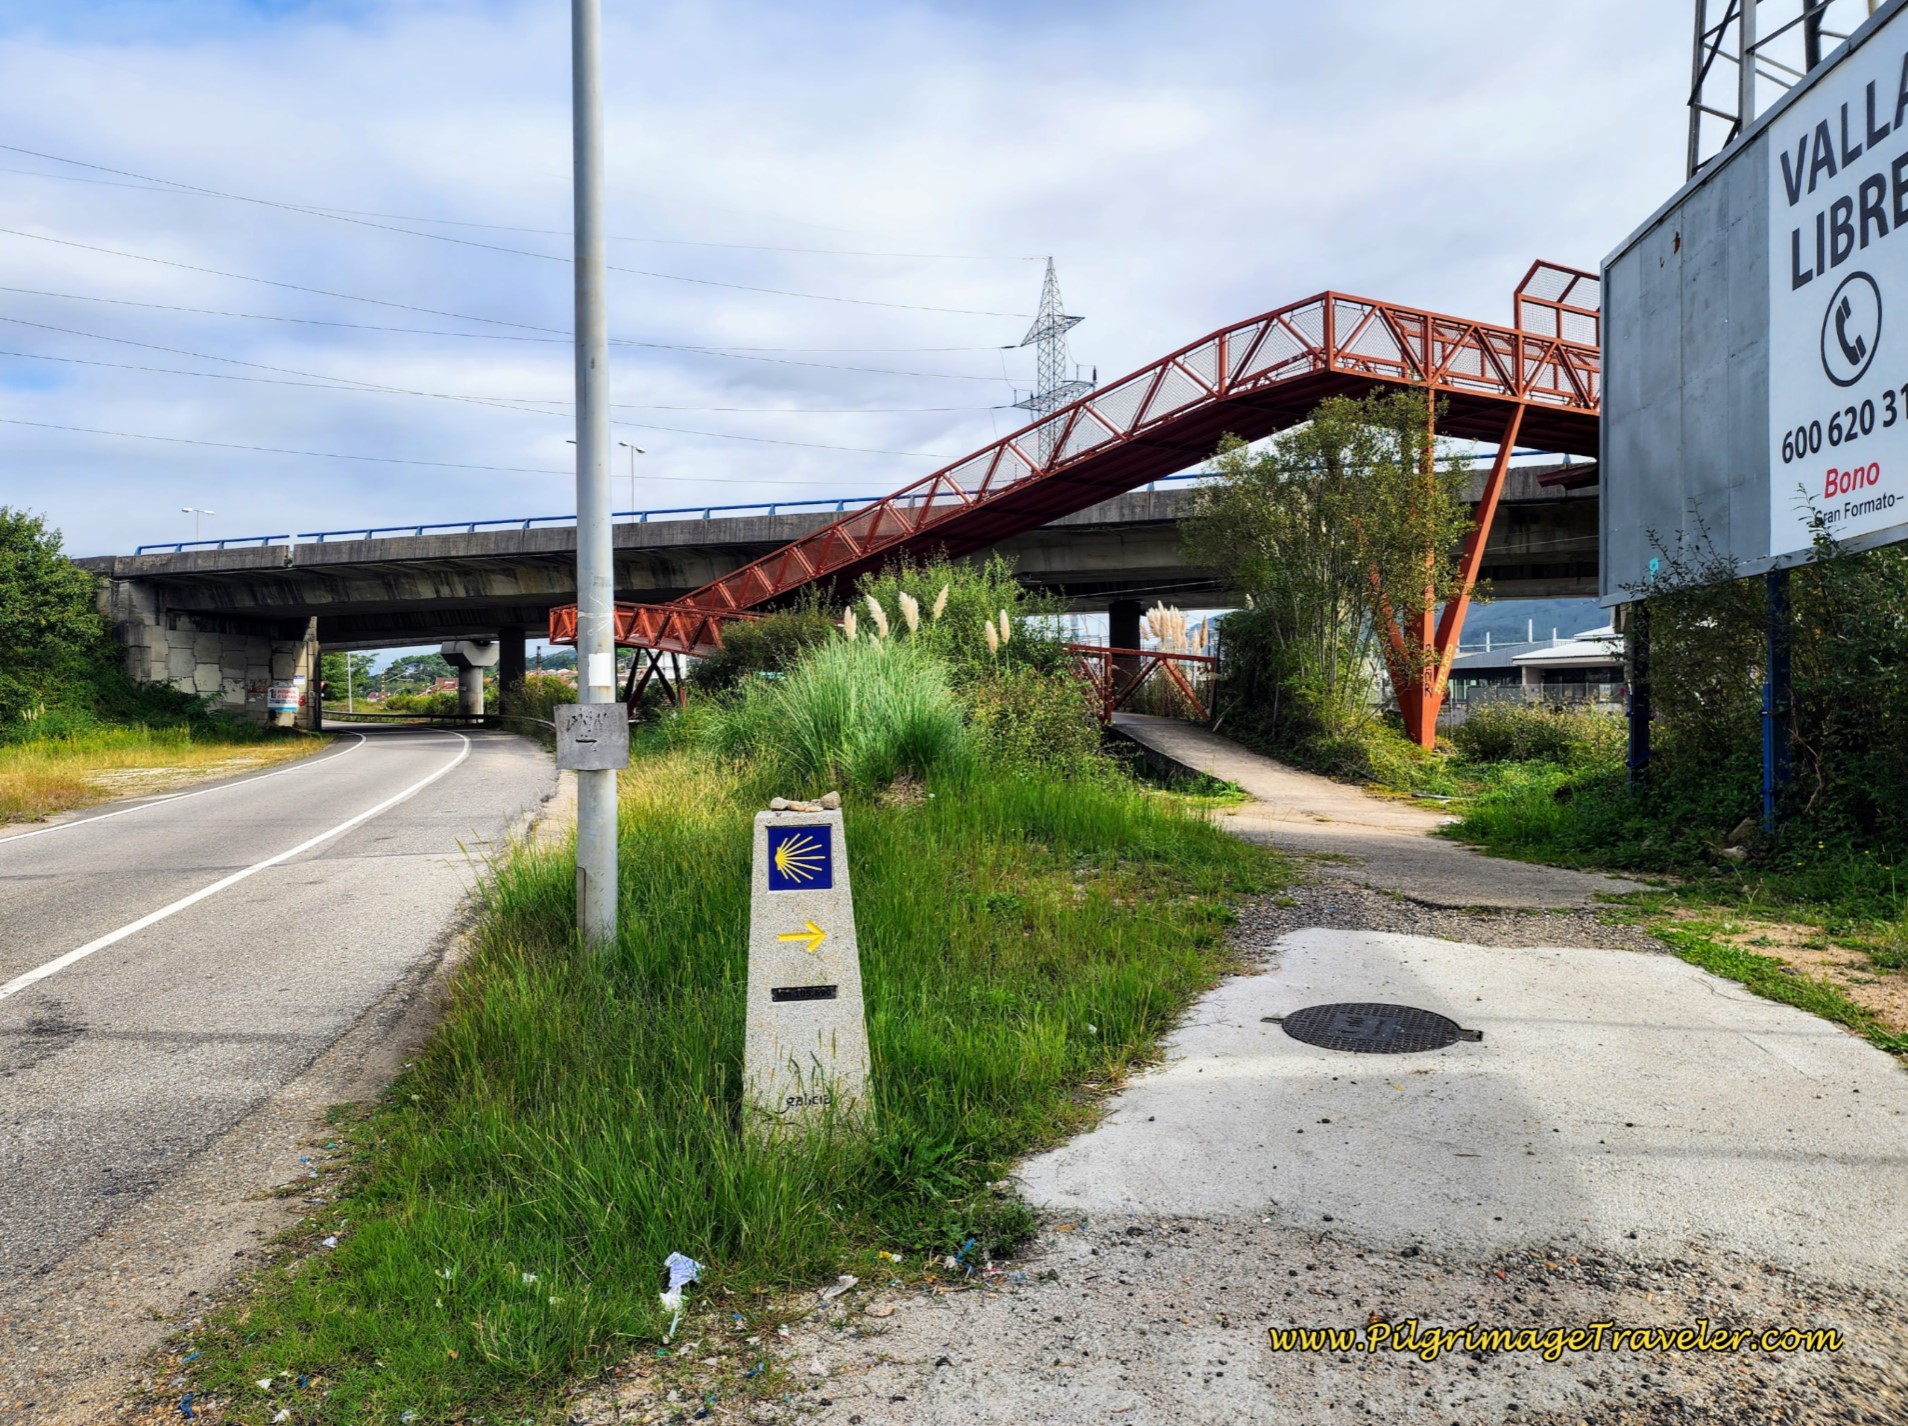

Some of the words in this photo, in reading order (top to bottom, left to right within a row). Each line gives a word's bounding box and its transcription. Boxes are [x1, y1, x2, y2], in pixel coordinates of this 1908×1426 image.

[1792, 151, 1908, 291] LIBRE
[1782, 420, 1822, 464] 600
[1828, 399, 1875, 447] 620
[1824, 462, 1880, 499] Bono
